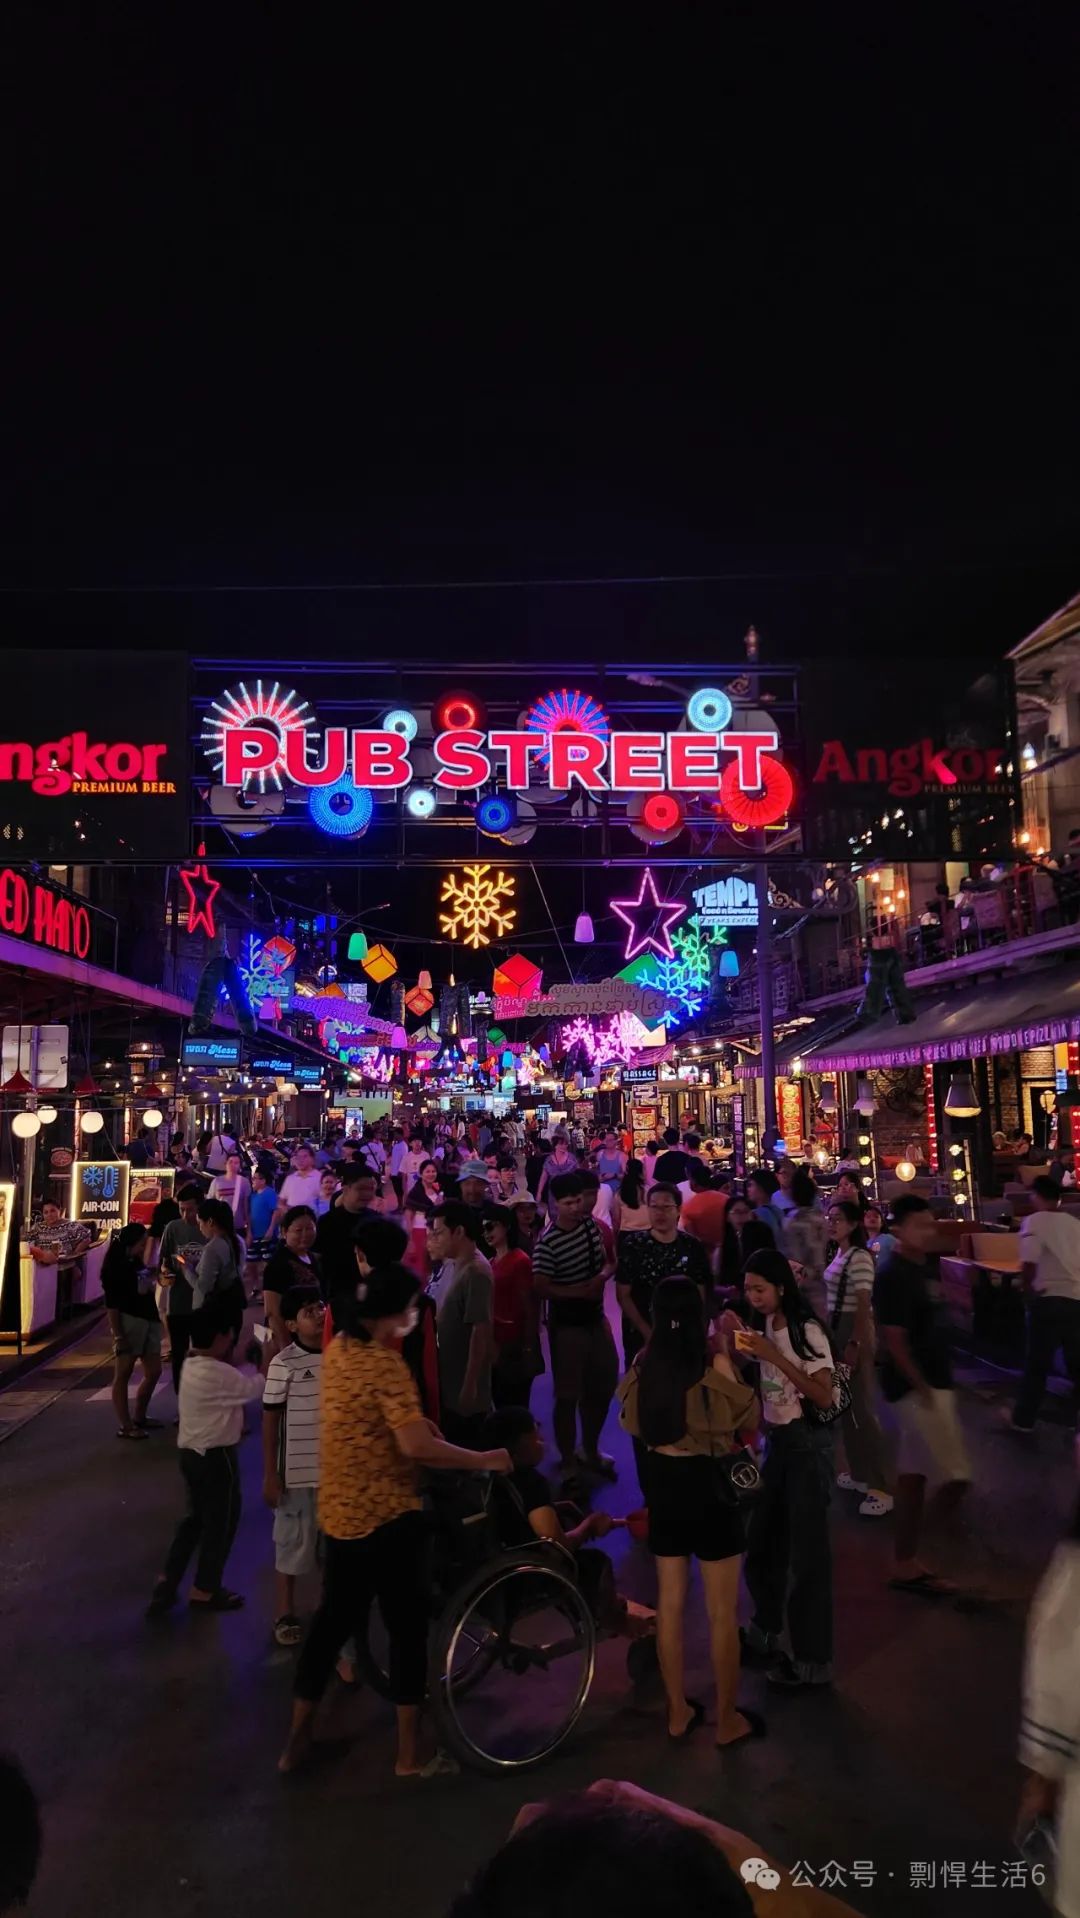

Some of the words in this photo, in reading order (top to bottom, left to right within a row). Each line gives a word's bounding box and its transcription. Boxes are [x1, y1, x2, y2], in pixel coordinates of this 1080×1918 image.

[223, 727, 413, 789] PUB
[433, 729, 778, 790] STREET
[813, 737, 1004, 797] Angkor
[72, 781, 138, 793] PREMIUM
[142, 781, 177, 793] BEER
[35, 886, 90, 958] PIANO
[623, 1070, 657, 1078] MASSAGE
[81, 1200, 120, 1213] AIR-CON
